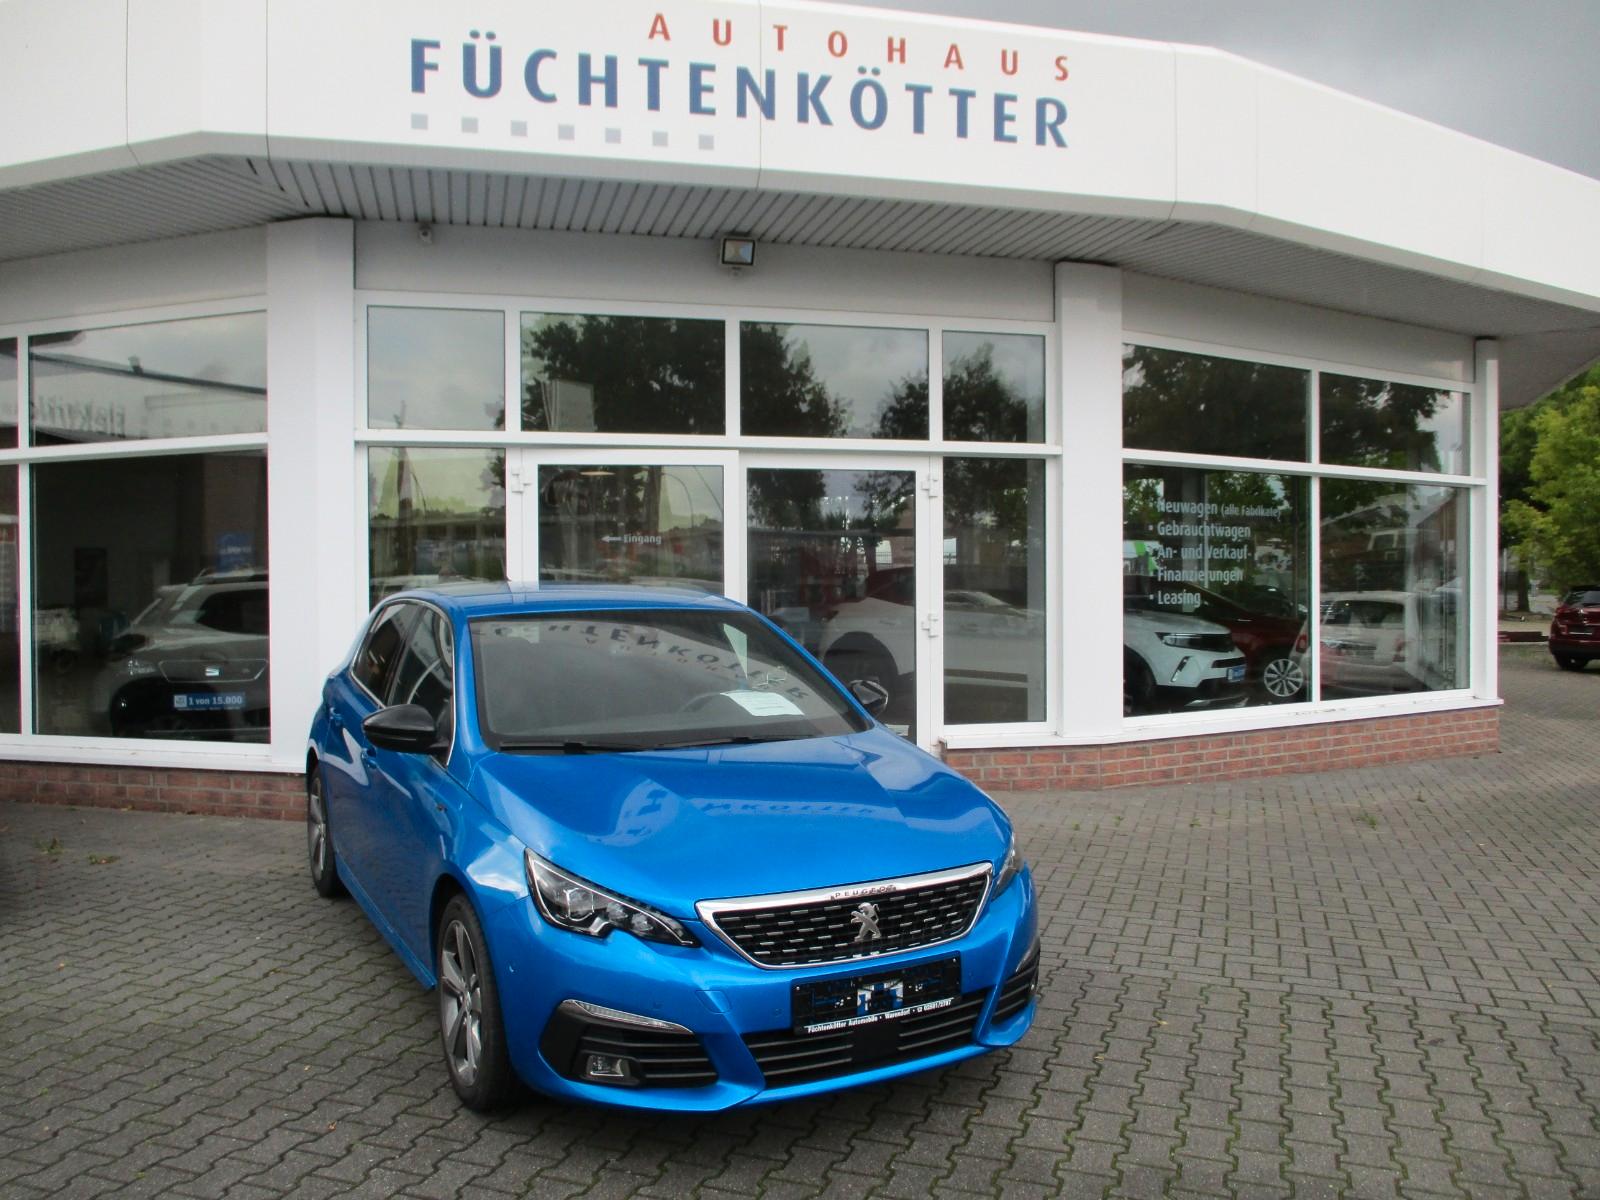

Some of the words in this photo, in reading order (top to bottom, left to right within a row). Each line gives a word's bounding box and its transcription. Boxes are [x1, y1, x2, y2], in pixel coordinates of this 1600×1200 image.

[648, 12, 1070, 82] AUTOHAUS
[410, 29, 1069, 149] FÜCHTENKÖTTER
[1157, 499, 1218, 517] Neuwagen
[623, 533, 662, 545] Eingang
[1157, 521, 1251, 541] Gebrauchtwagen
[1181, 545, 1201, 560] und
[1157, 568, 1244, 585] Finanzierungen
[1157, 590, 1201, 606] Leasing
